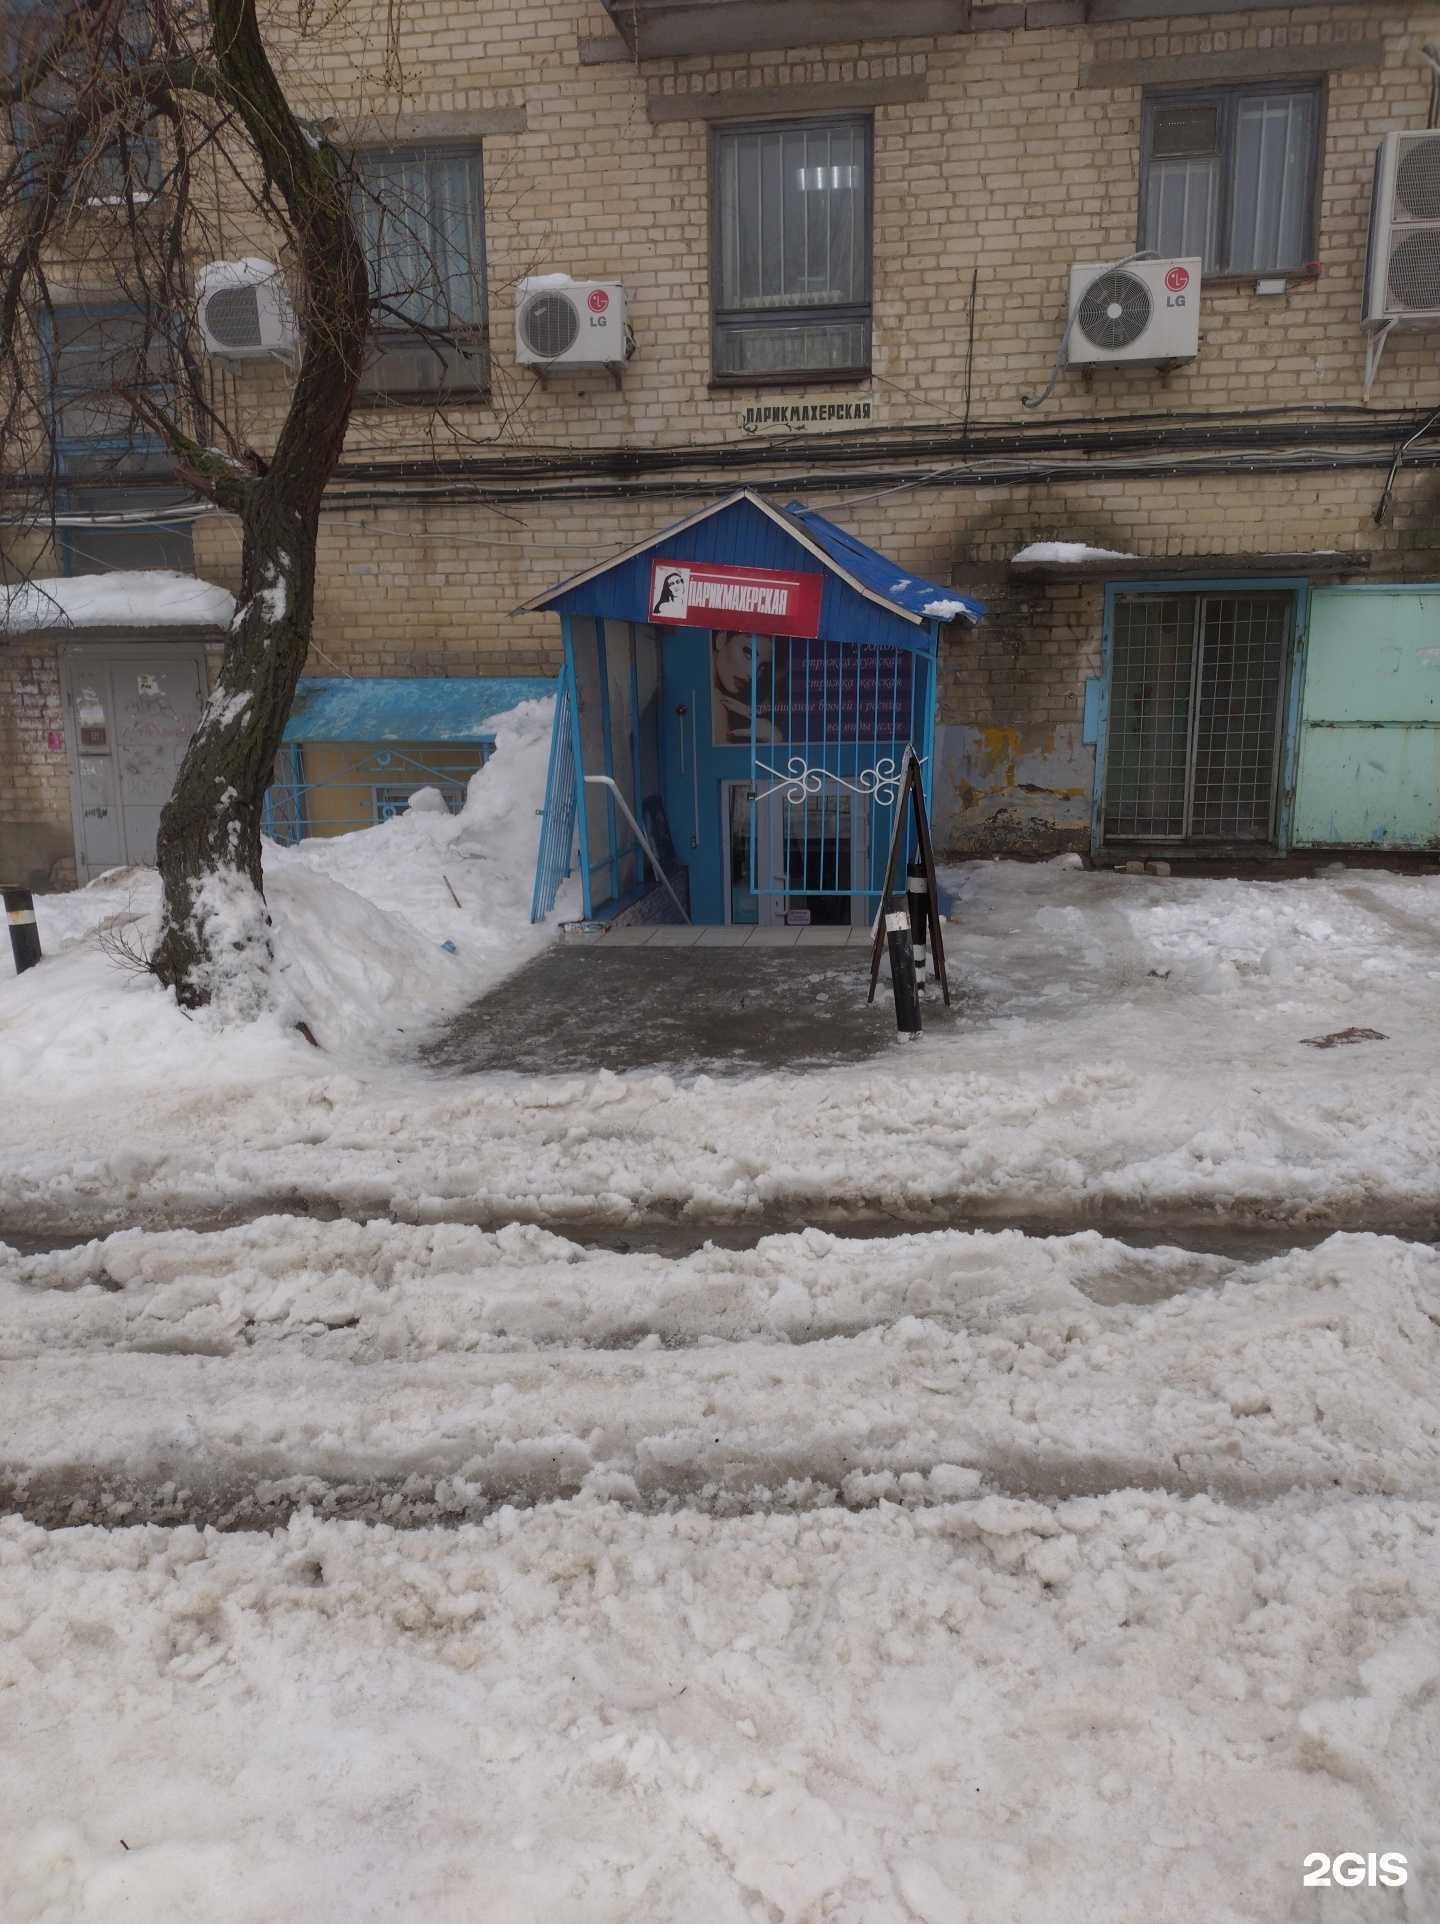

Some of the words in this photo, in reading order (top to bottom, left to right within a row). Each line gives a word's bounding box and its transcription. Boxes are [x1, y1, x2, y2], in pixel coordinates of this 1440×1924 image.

[1166, 295, 1186, 307] LG
[589, 316, 607, 327] LG
[746, 403, 871, 424] ПАРИКМАХЕРСКАЯ
[688, 580, 788, 616] ПАРИКМАХЕРСКАЯ
